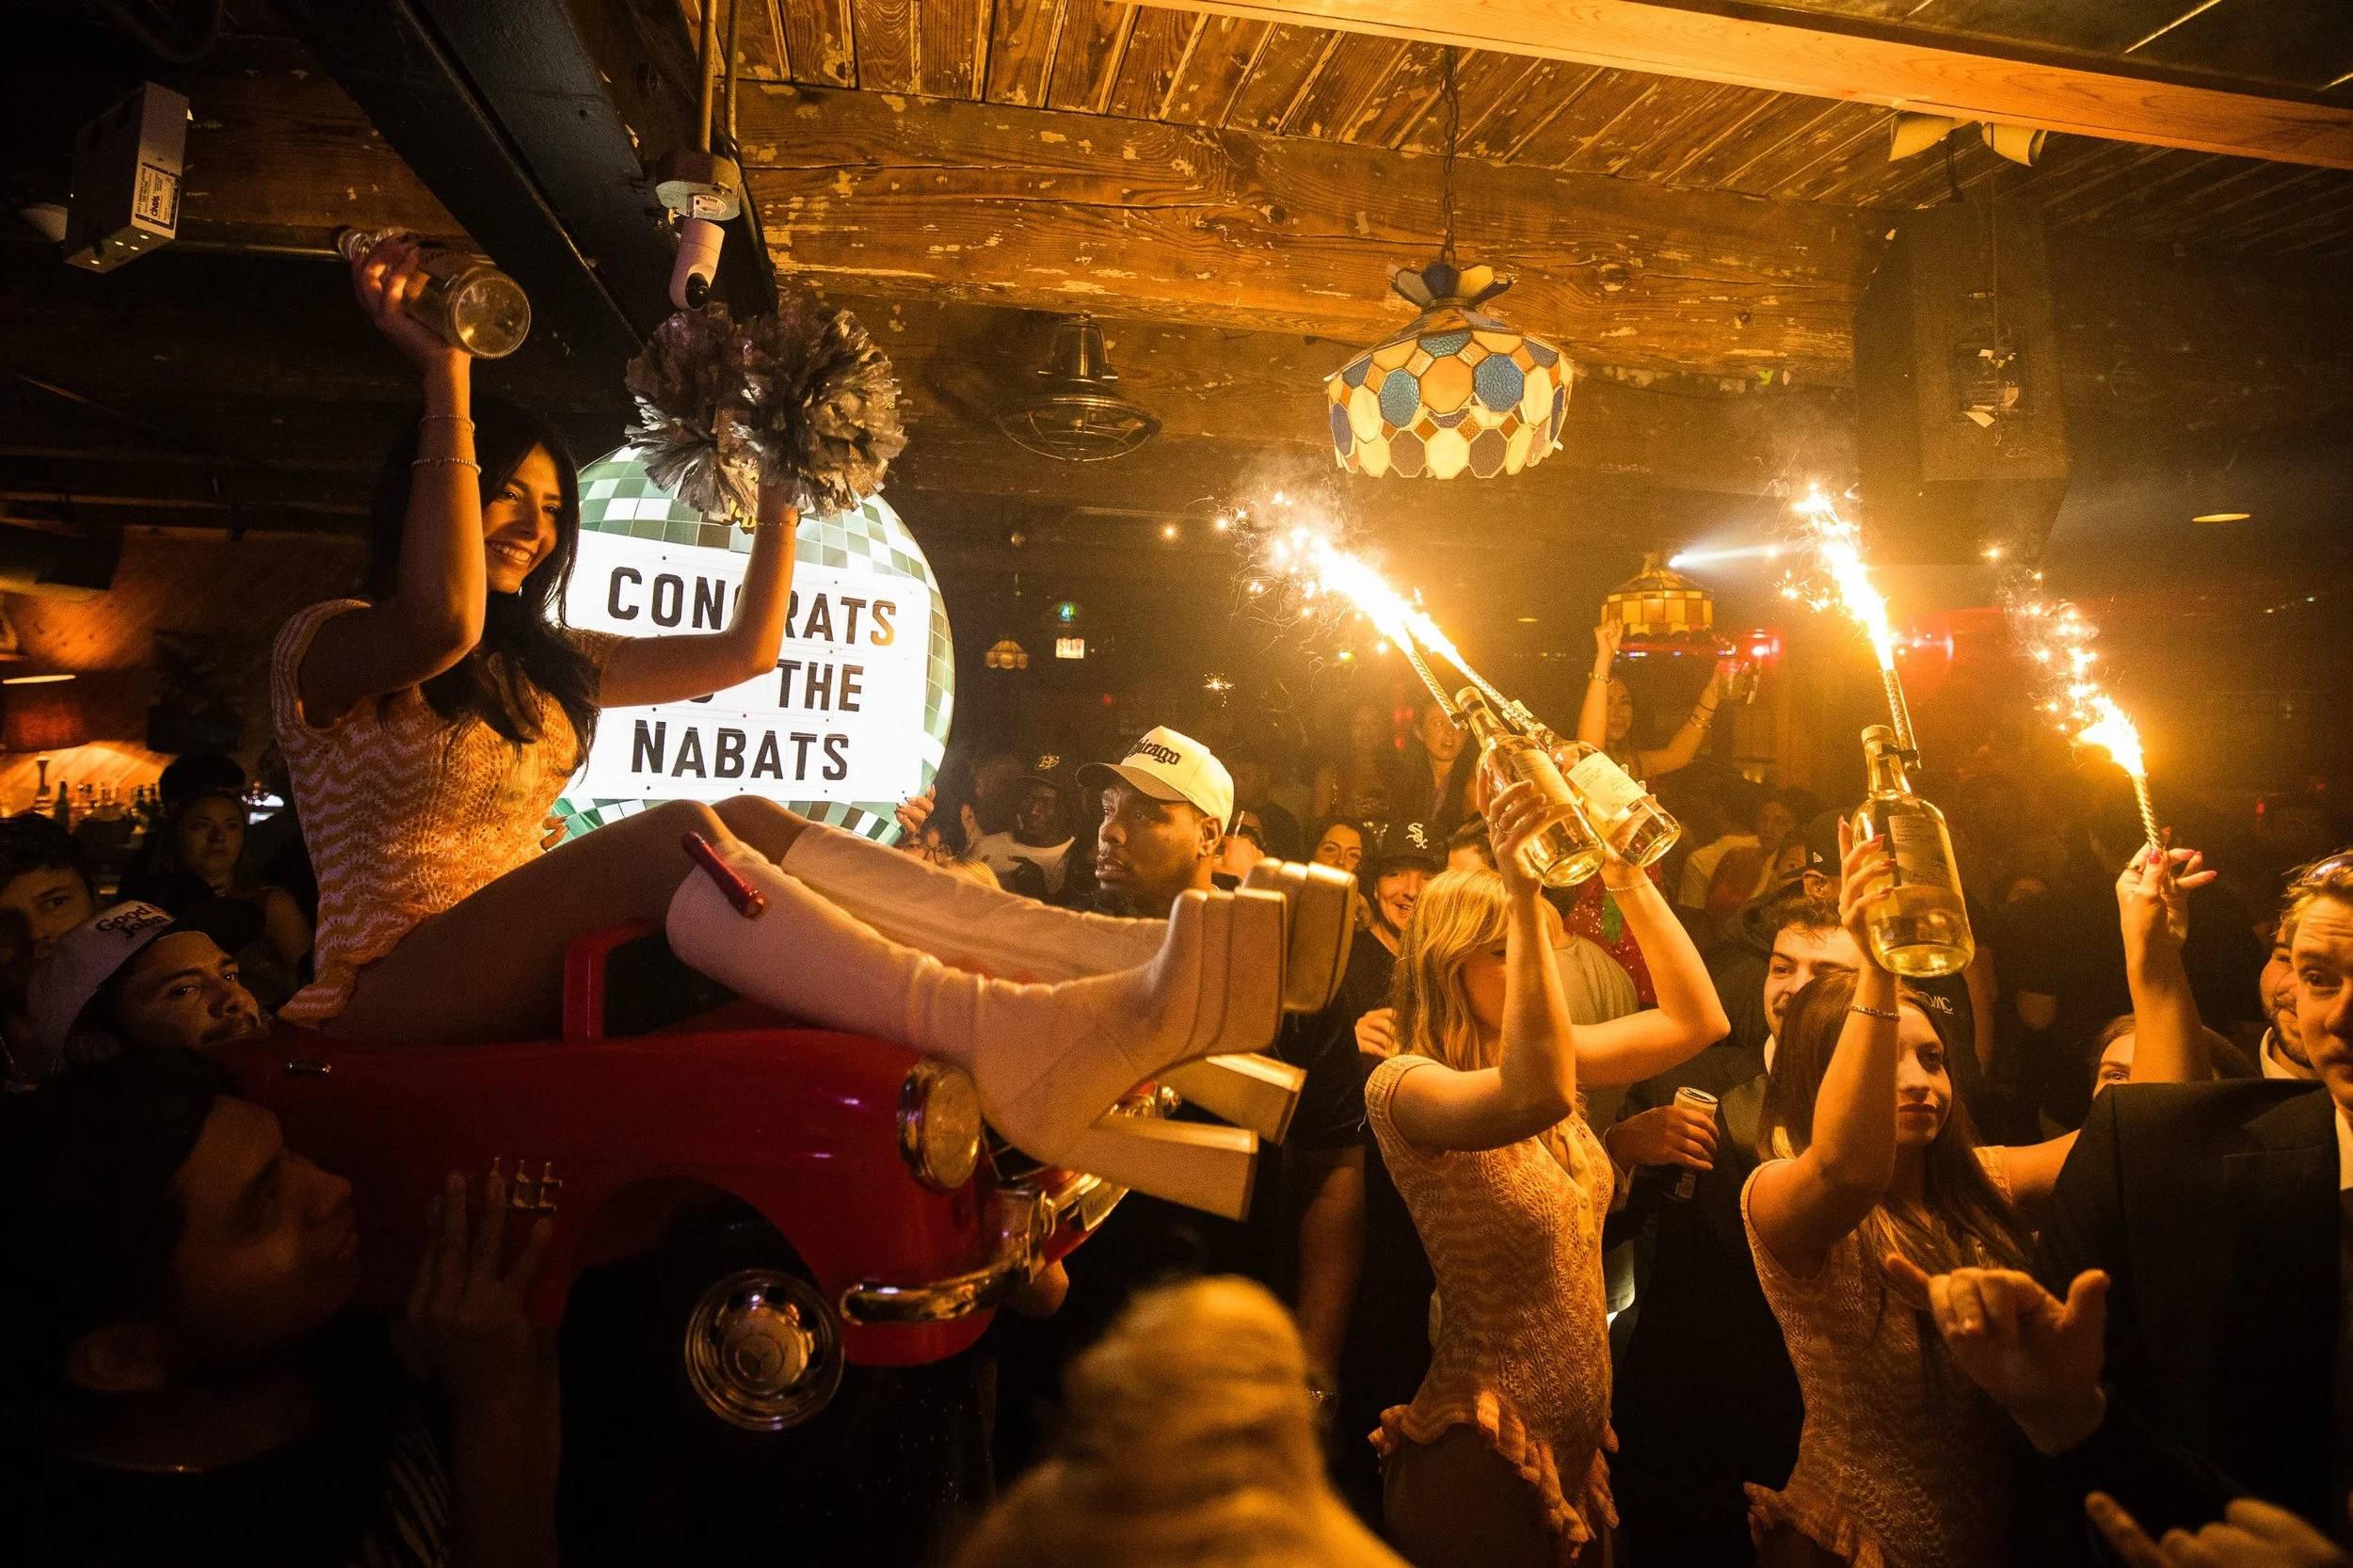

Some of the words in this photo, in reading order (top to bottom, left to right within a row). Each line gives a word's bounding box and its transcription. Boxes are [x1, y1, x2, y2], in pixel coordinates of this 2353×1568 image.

[607, 567, 896, 646] CONRATS
[776, 659, 863, 712] THE
[632, 719, 849, 781] NABATS
[1406, 823, 1428, 849] Sox
[95, 905, 152, 931] Good
